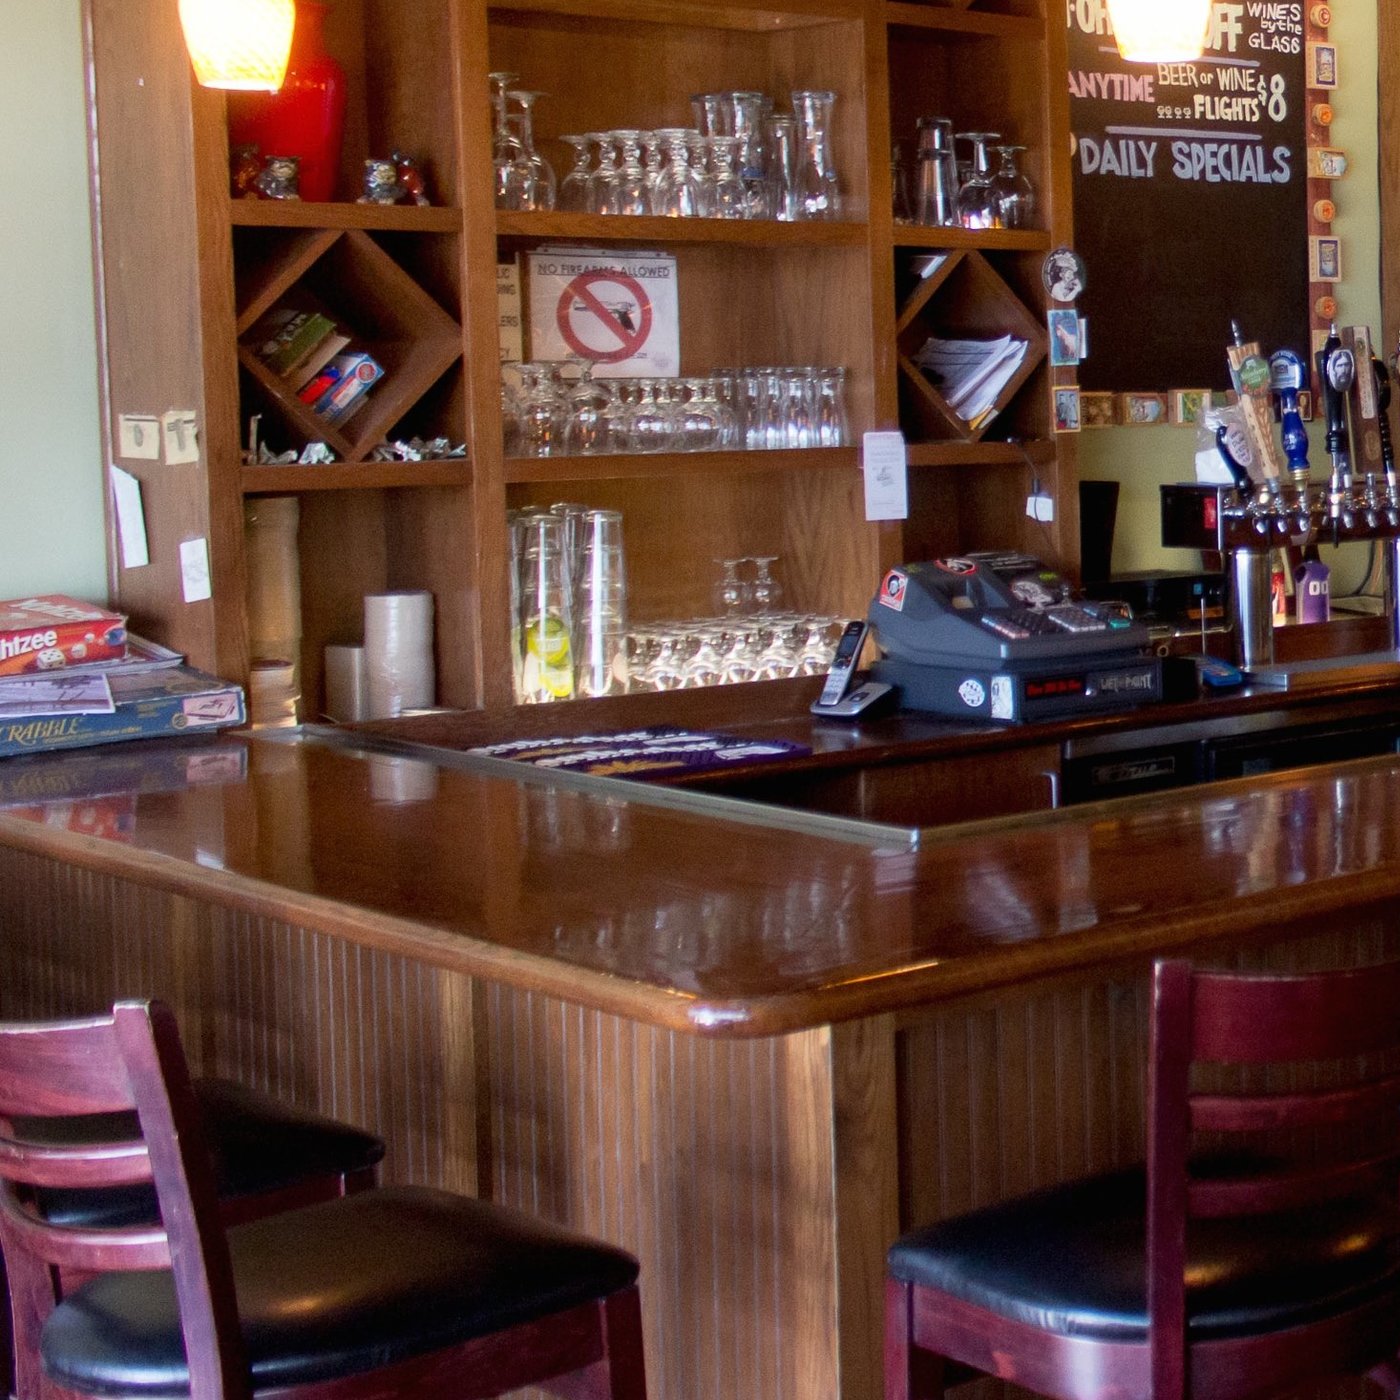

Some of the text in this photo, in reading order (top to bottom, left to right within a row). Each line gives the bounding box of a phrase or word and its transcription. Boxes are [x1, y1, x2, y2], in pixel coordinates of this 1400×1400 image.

[1247, 1, 1302, 21] WINES
[1248, 33, 1301, 54] GLASS
[1067, 71, 1155, 103] ANYTIME
[1157, 63, 1199, 88] BEER
[1216, 67, 1256, 92] WINE
[1193, 94, 1260, 122] FLIGHTS
[1079, 137, 1291, 184] DAILY SPECIALS
[537, 263, 558, 275] NO
[620, 266, 671, 279] ALLOWED
